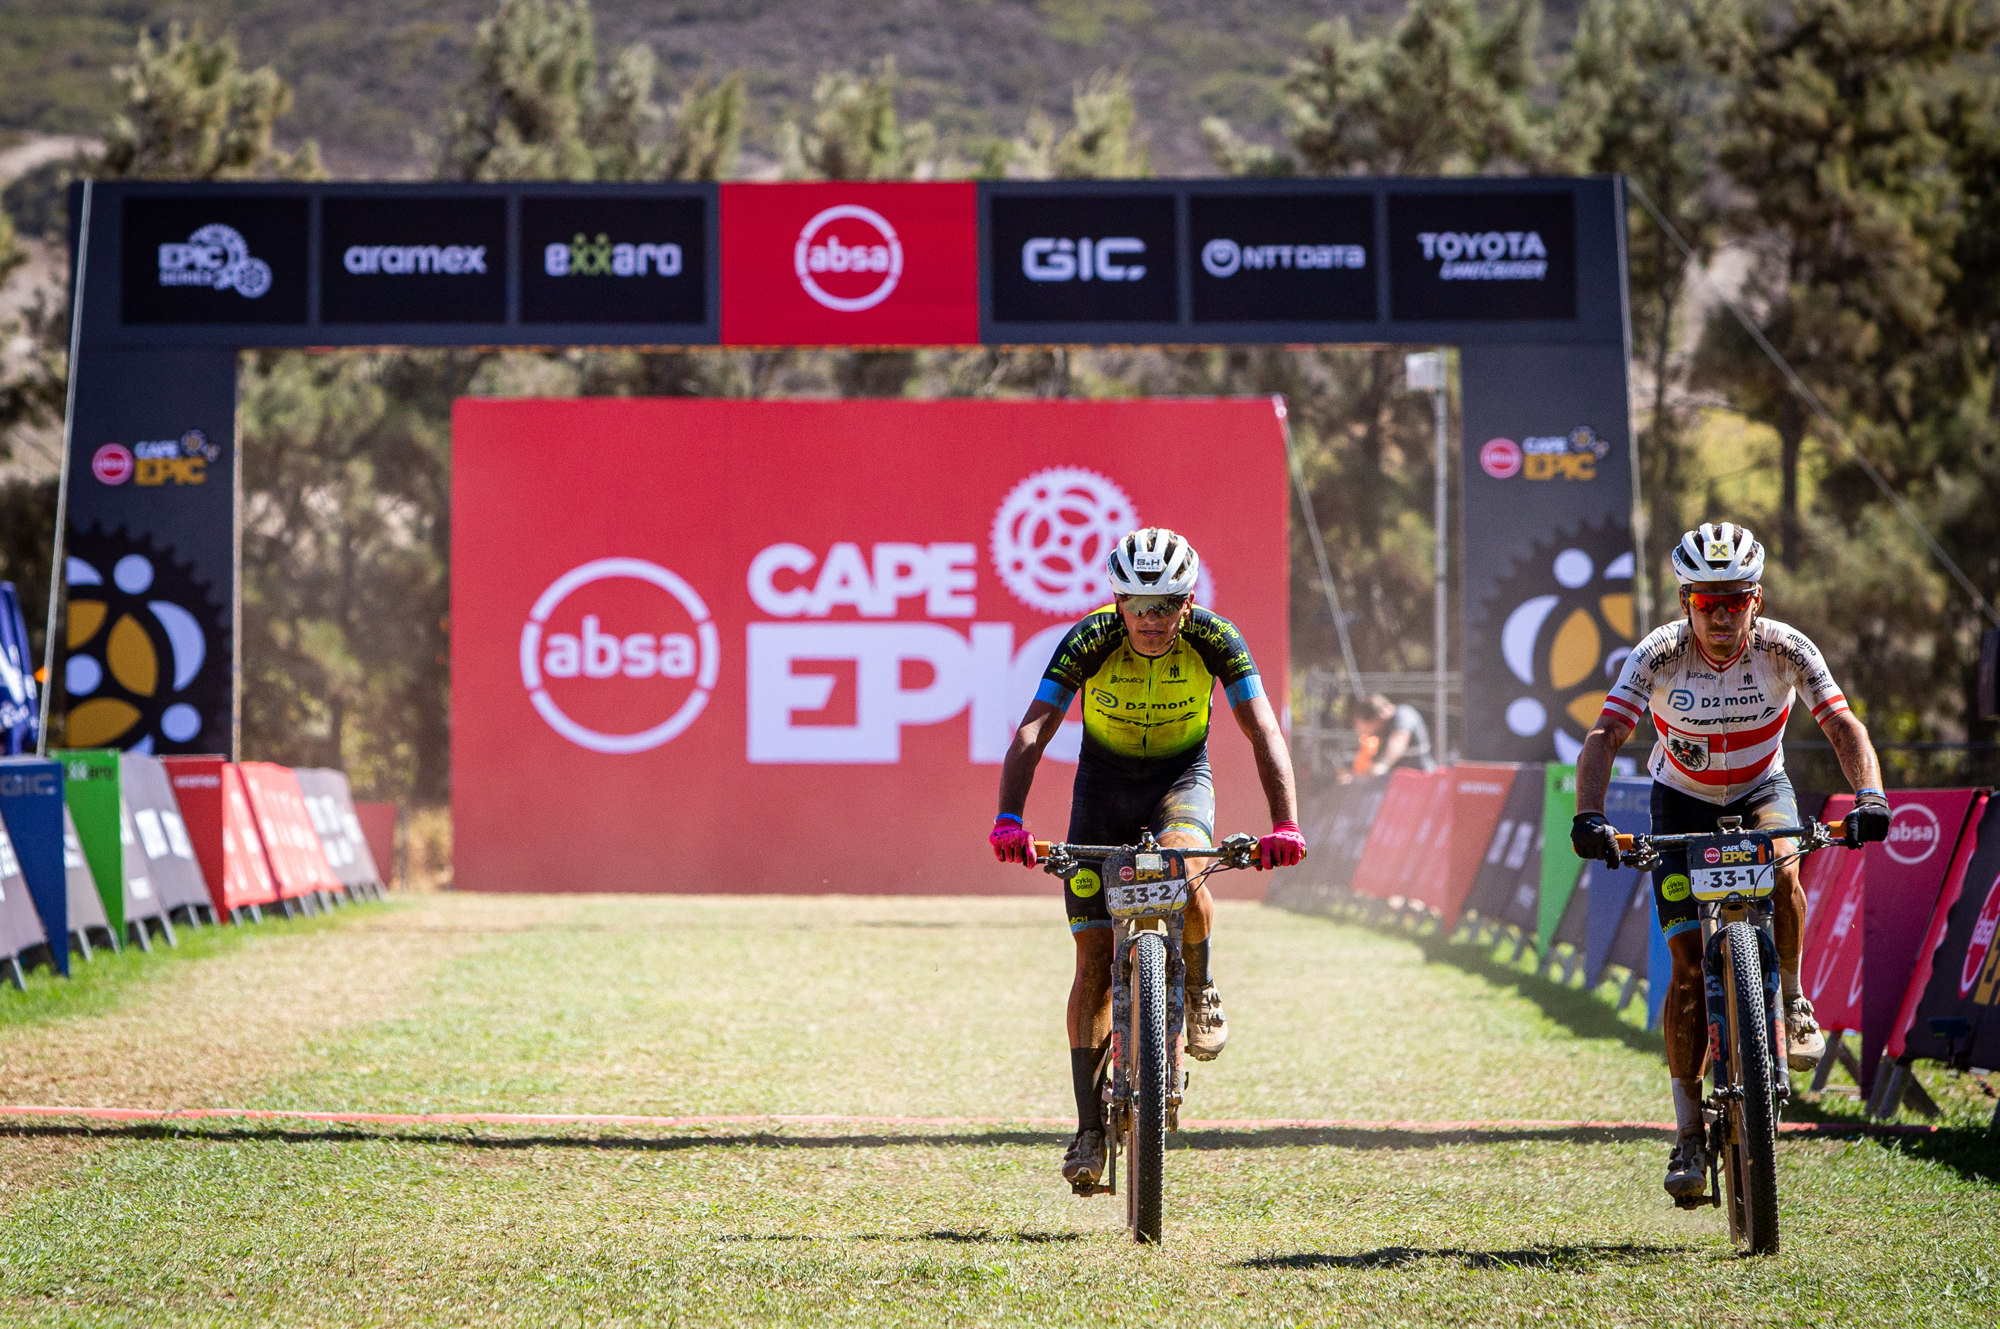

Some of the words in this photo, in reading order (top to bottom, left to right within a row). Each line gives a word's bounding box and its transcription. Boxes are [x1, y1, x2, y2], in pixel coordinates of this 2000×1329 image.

[544, 232, 683, 277] exxaro
[808, 235, 889, 272] absa
[1416, 231, 1547, 260] TOYOTA
[343, 245, 488, 274] aramex
[746, 541, 978, 619] CAPE
[543, 613, 697, 679] absa
[1125, 702, 1147, 710] D2
[1151, 696, 1196, 710] mont
[1701, 697, 1720, 708] D2
[1725, 692, 1765, 706] mont
[1889, 820, 1933, 842] absa
[1721, 851, 1752, 864] EPIC
[1075, 877, 1093, 885] cyklo
[1076, 882, 1094, 891] point
[1666, 881, 1684, 891] cyklo
[1709, 869, 1756, 889] 33-1
[1122, 885, 1172, 905] 33-2
[1668, 886, 1686, 896] point
